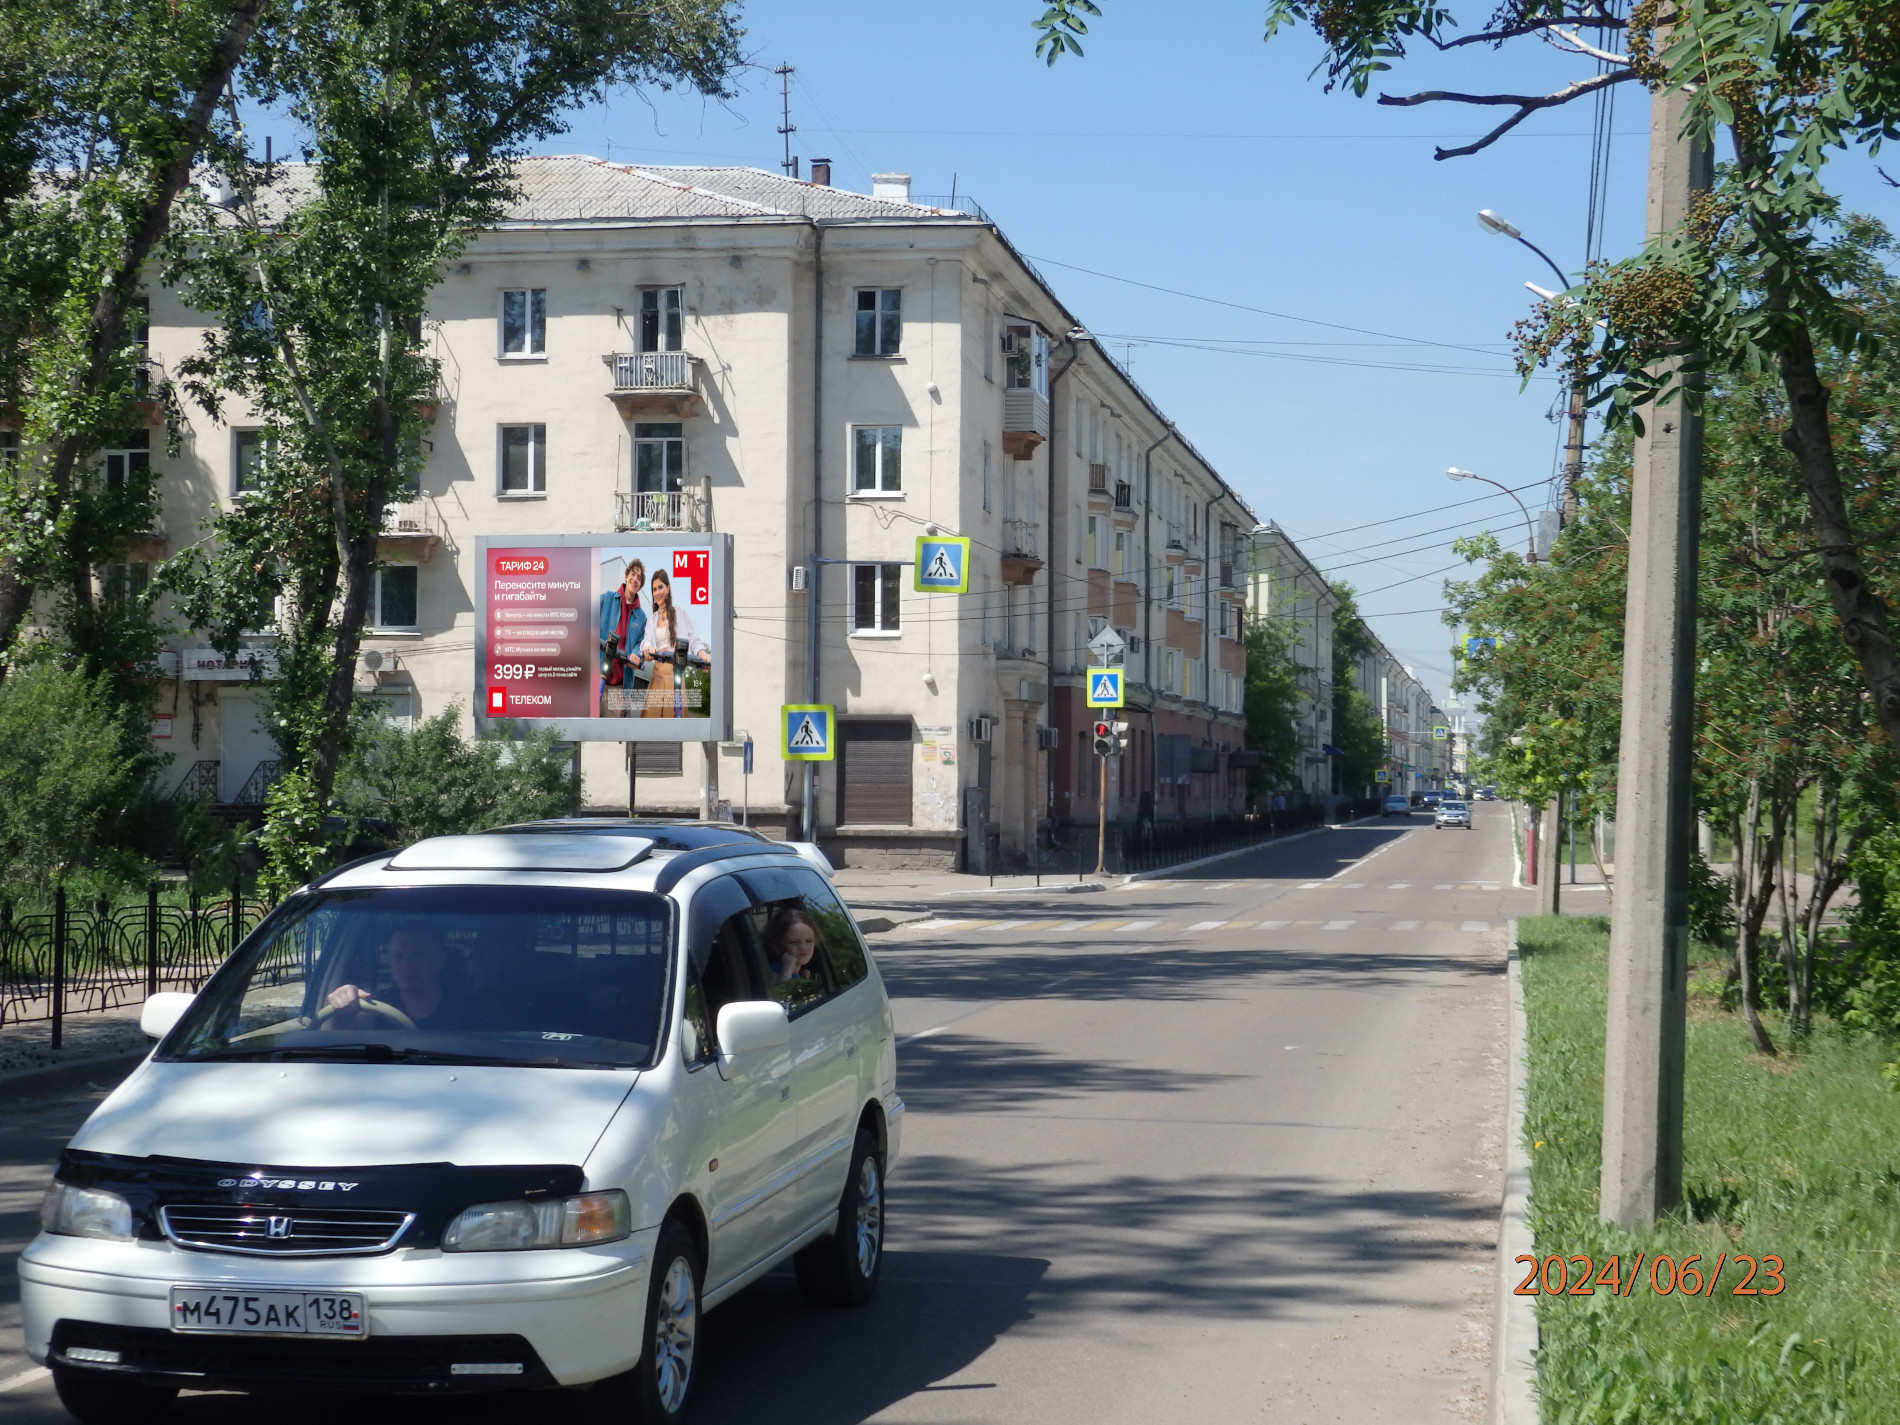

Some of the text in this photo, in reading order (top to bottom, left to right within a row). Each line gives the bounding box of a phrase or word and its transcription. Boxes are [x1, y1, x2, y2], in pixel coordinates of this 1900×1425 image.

[500, 561, 545, 571] ТАРИФ 24
[494, 580, 581, 592] Переносите минуты
[494, 591, 547, 601] и гигабайты
[693, 679, 702, 687] 18+
[509, 695, 552, 705] ТЕЛЕКОМ
[217, 1178, 359, 1191] ODYSSEY
[308, 1297, 352, 1321] 138
[320, 1320, 342, 1330] RUS
